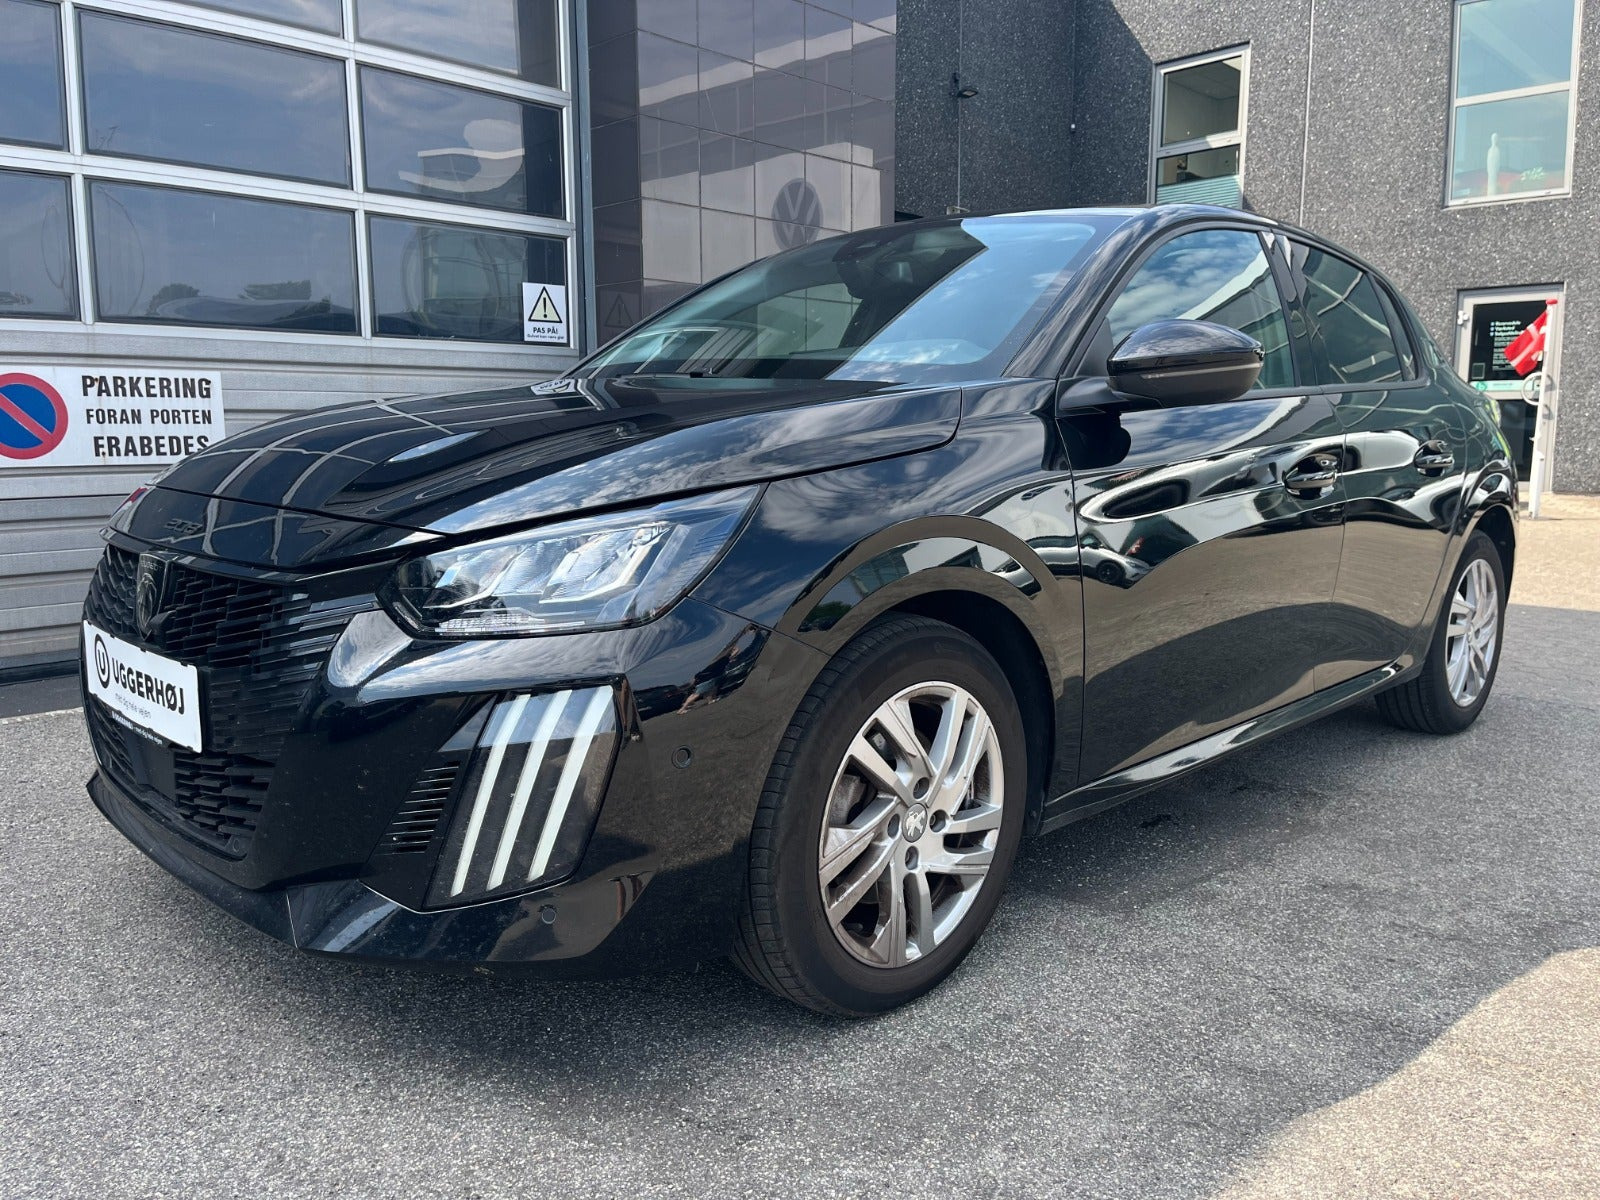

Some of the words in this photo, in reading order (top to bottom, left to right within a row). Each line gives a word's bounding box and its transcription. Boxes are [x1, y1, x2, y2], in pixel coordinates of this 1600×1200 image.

[81, 375, 212, 399] PARKERING
[85, 408, 142, 425] FORAN
[150, 409, 212, 425] PORTEN
[93, 435, 210, 457] FRABEDES
[164, 518, 203, 535] 208
[111, 657, 185, 715] UGGERHØJ
